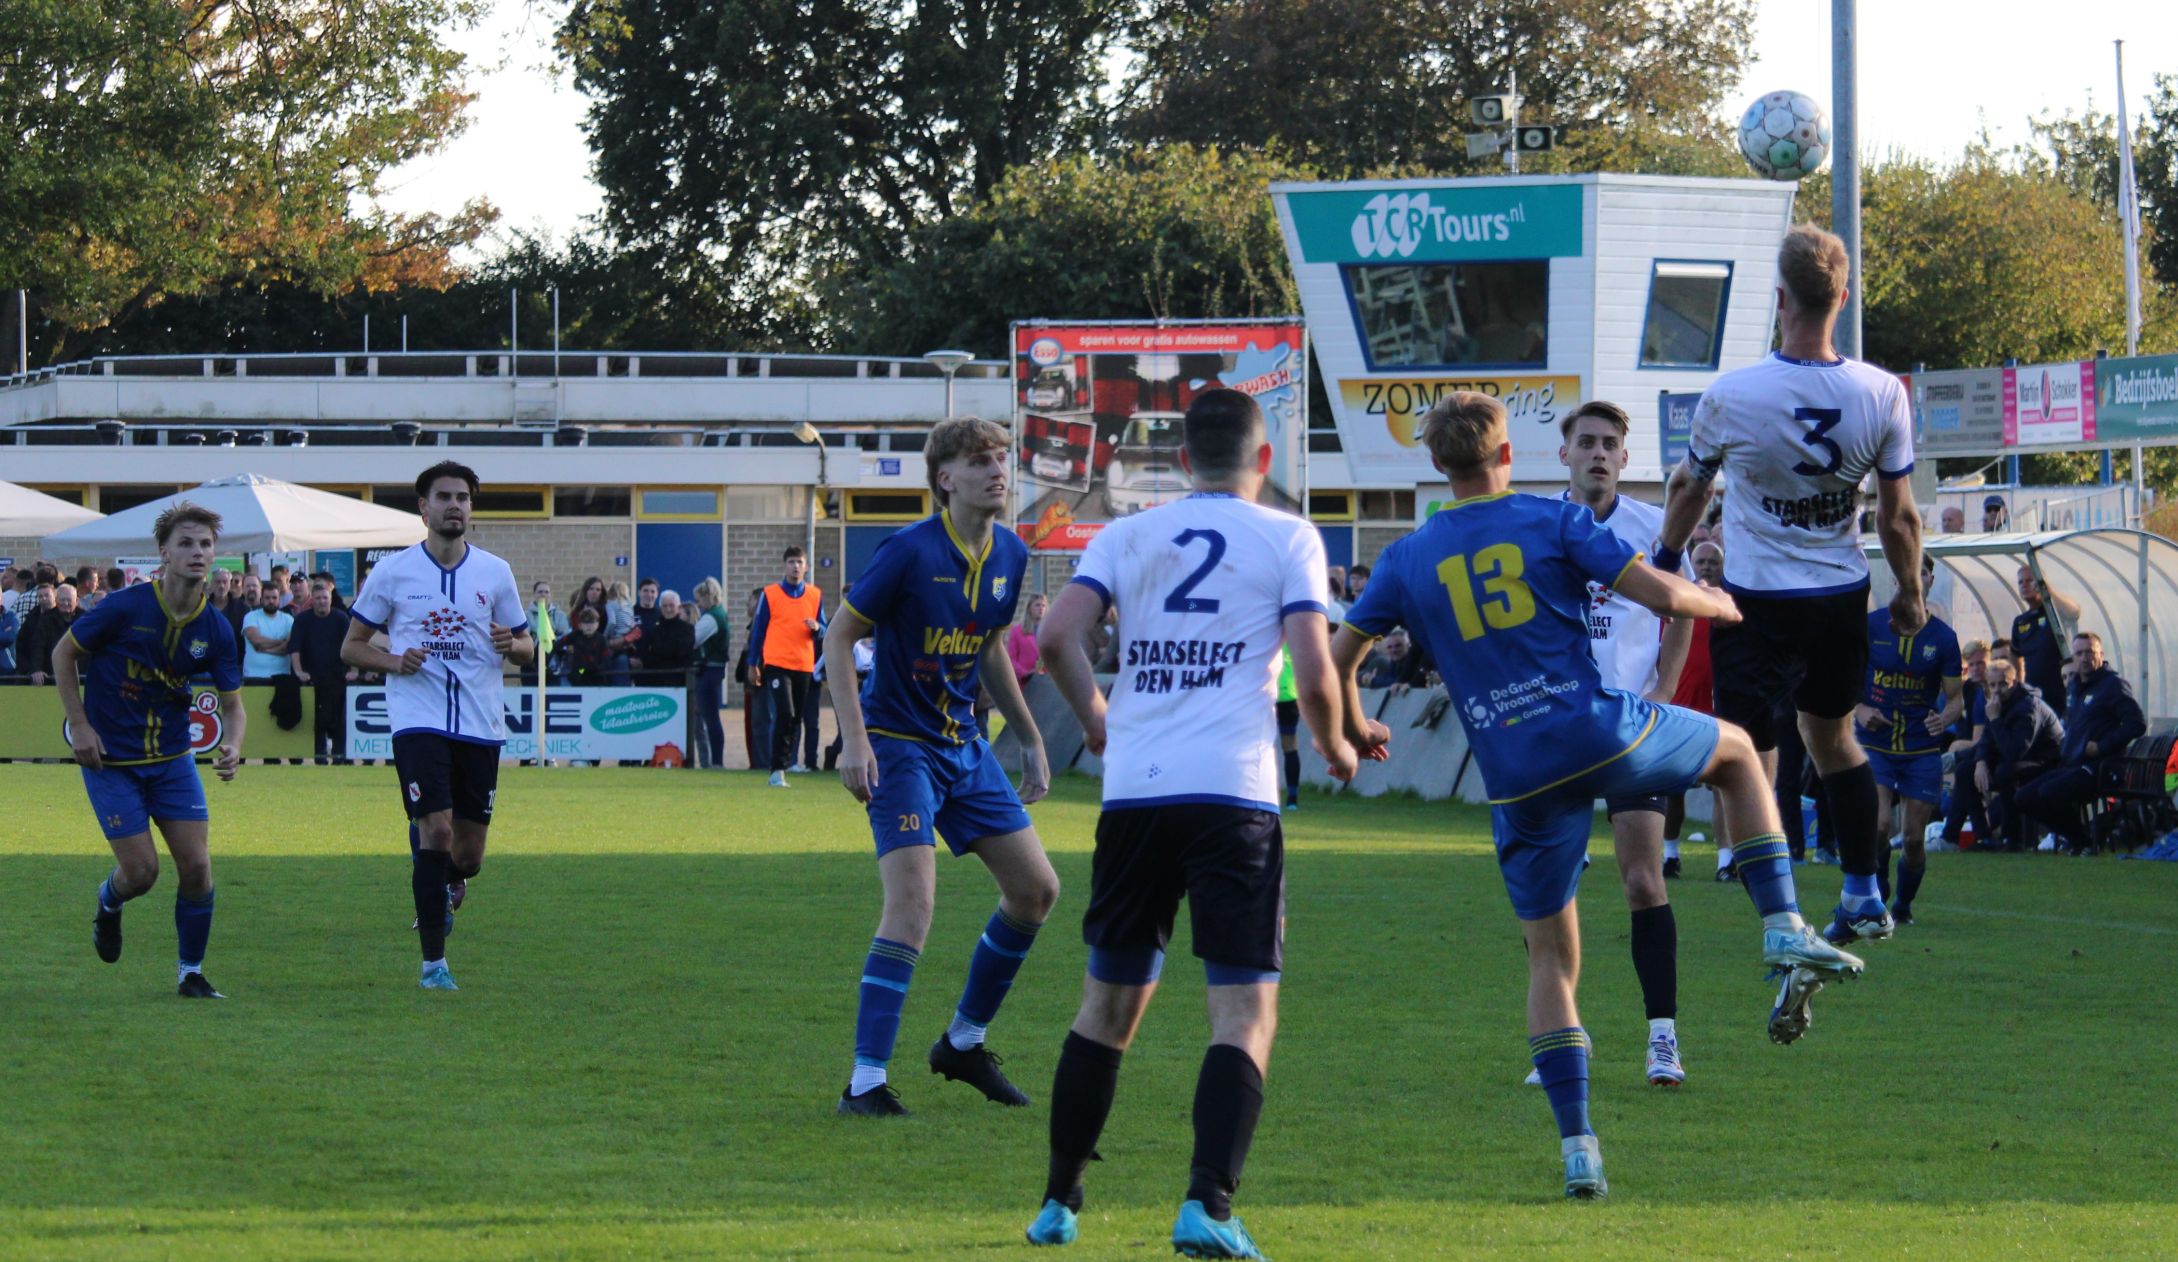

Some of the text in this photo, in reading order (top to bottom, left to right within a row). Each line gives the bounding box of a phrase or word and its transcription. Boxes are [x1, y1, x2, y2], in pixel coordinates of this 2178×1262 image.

[1079, 334, 1238, 347] sparen voor gratis autowassen
[2052, 379, 2078, 400] Schokker
[1792, 407, 1843, 476] 3
[1164, 528, 1227, 614] 2
[1436, 543, 1536, 641] 13
[923, 626, 990, 656] Veltin
[1590, 628, 1608, 640] AM
[1134, 669, 1174, 694] DEN
[1494, 678, 1580, 714] Vroomshoop
[1522, 704, 1552, 720] Groep
[898, 813, 921, 832] 20
